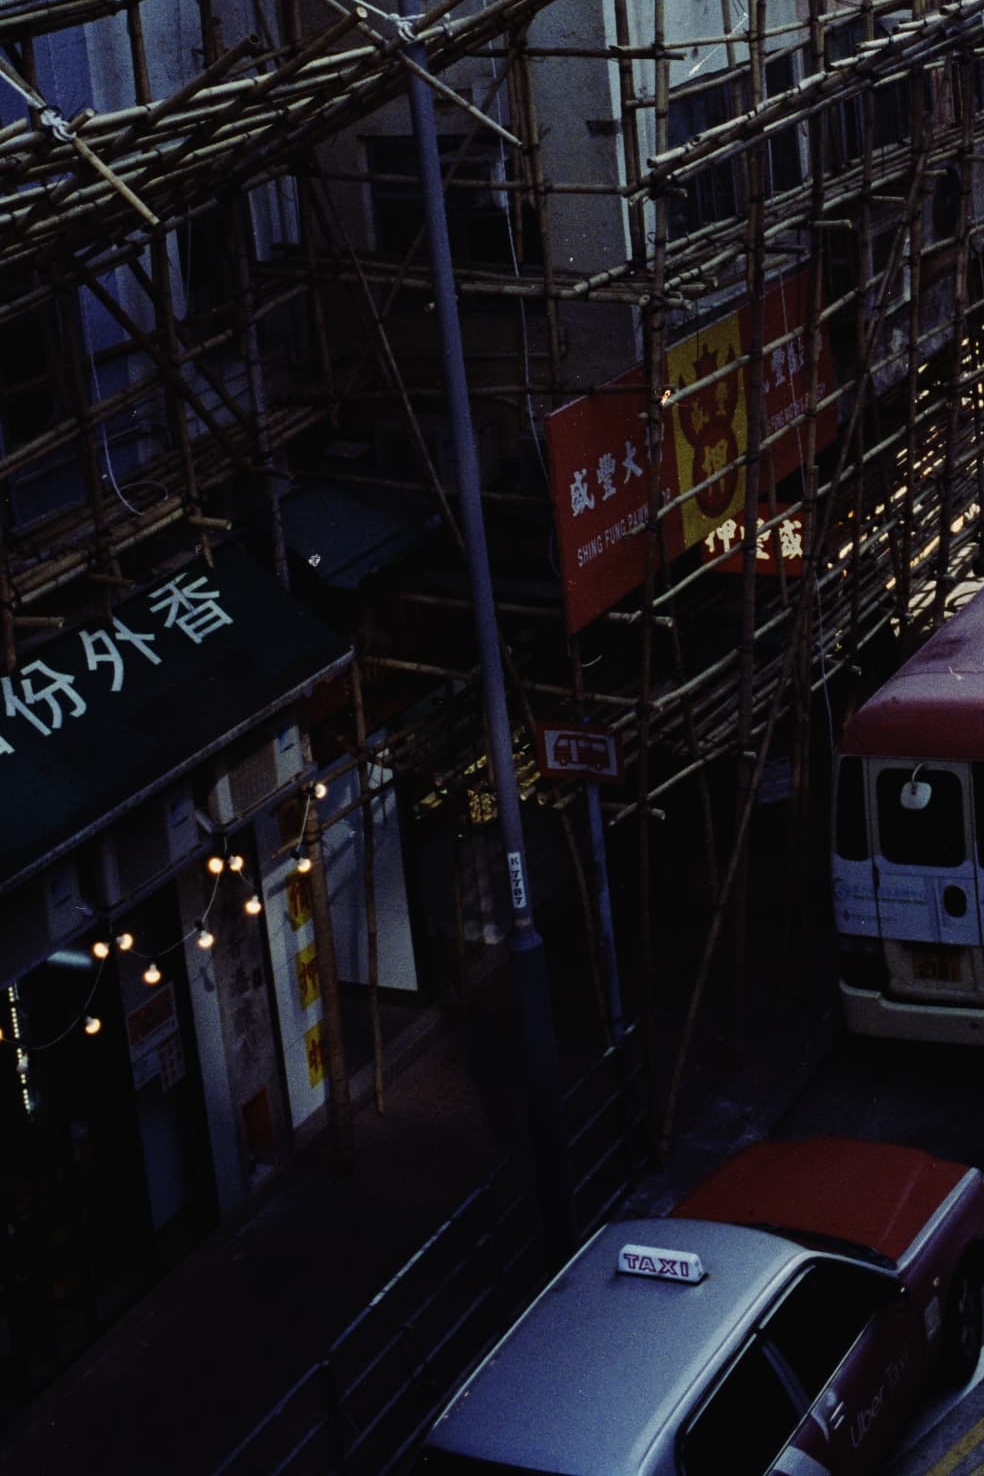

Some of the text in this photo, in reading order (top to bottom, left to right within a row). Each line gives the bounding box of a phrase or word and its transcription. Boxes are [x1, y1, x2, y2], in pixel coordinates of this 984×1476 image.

[576, 534, 603, 567] SHING
[603, 518, 626, 547] FUNG
[0, 572, 235, 755] 份外香
[623, 1252, 690, 1277] TAXI
